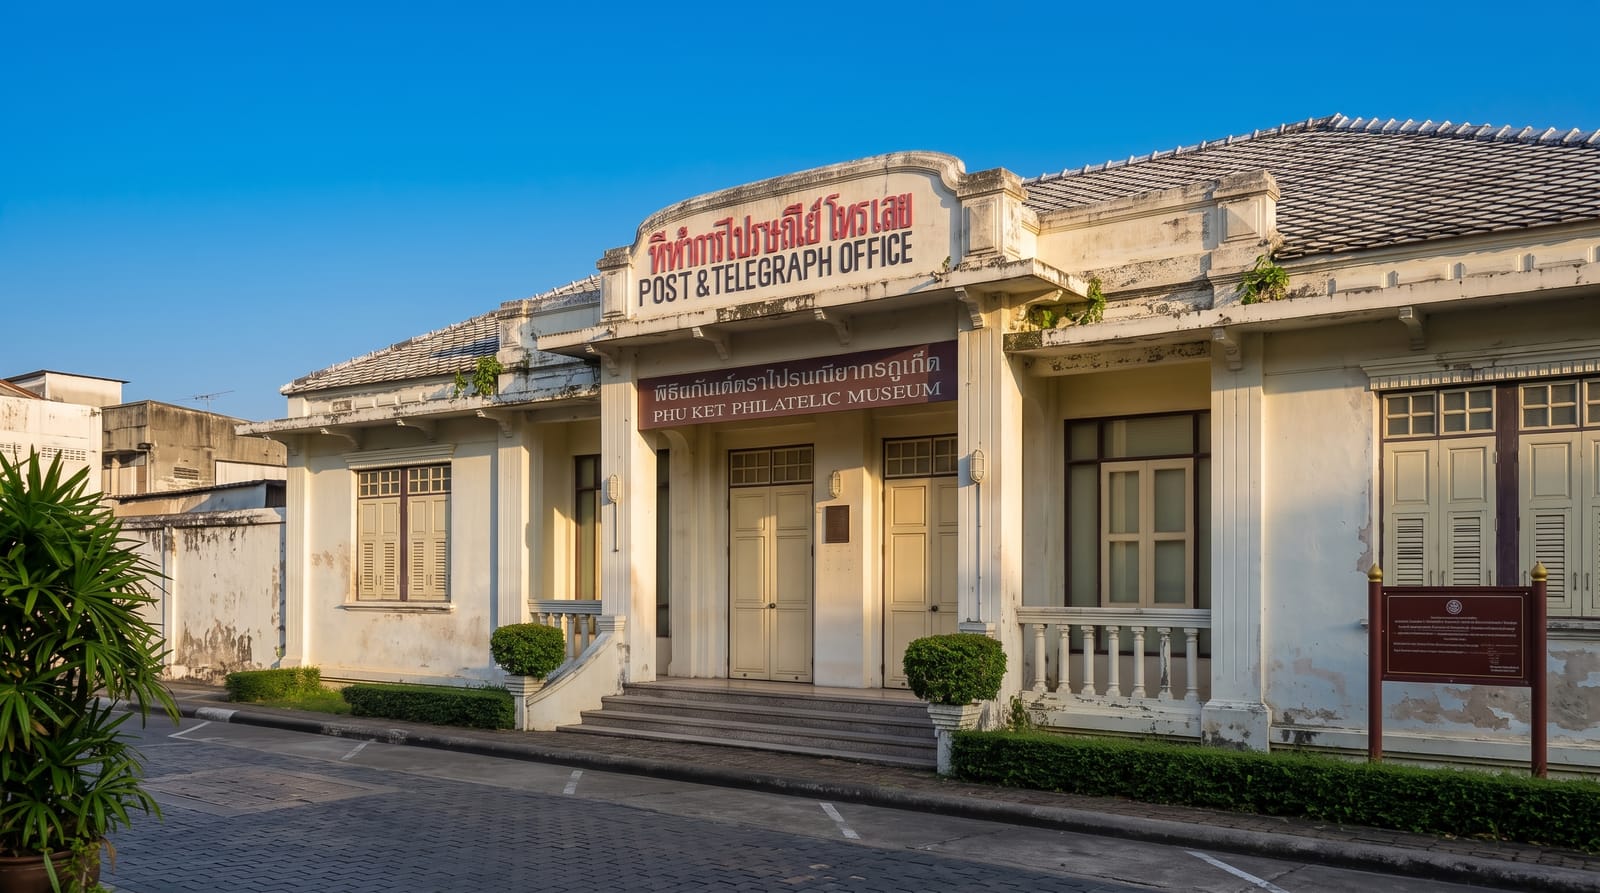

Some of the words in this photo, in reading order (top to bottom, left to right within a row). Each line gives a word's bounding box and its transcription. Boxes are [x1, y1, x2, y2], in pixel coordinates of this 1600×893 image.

[639, 271, 692, 307] POST
[696, 269, 710, 298] &
[711, 246, 832, 295] TELEGRAPH
[840, 231, 913, 274] OFFICE
[653, 407, 687, 423] PHU
[691, 404, 725, 419] KET
[731, 391, 841, 415] PHILATELIC
[847, 381, 942, 404] MUSEUM
